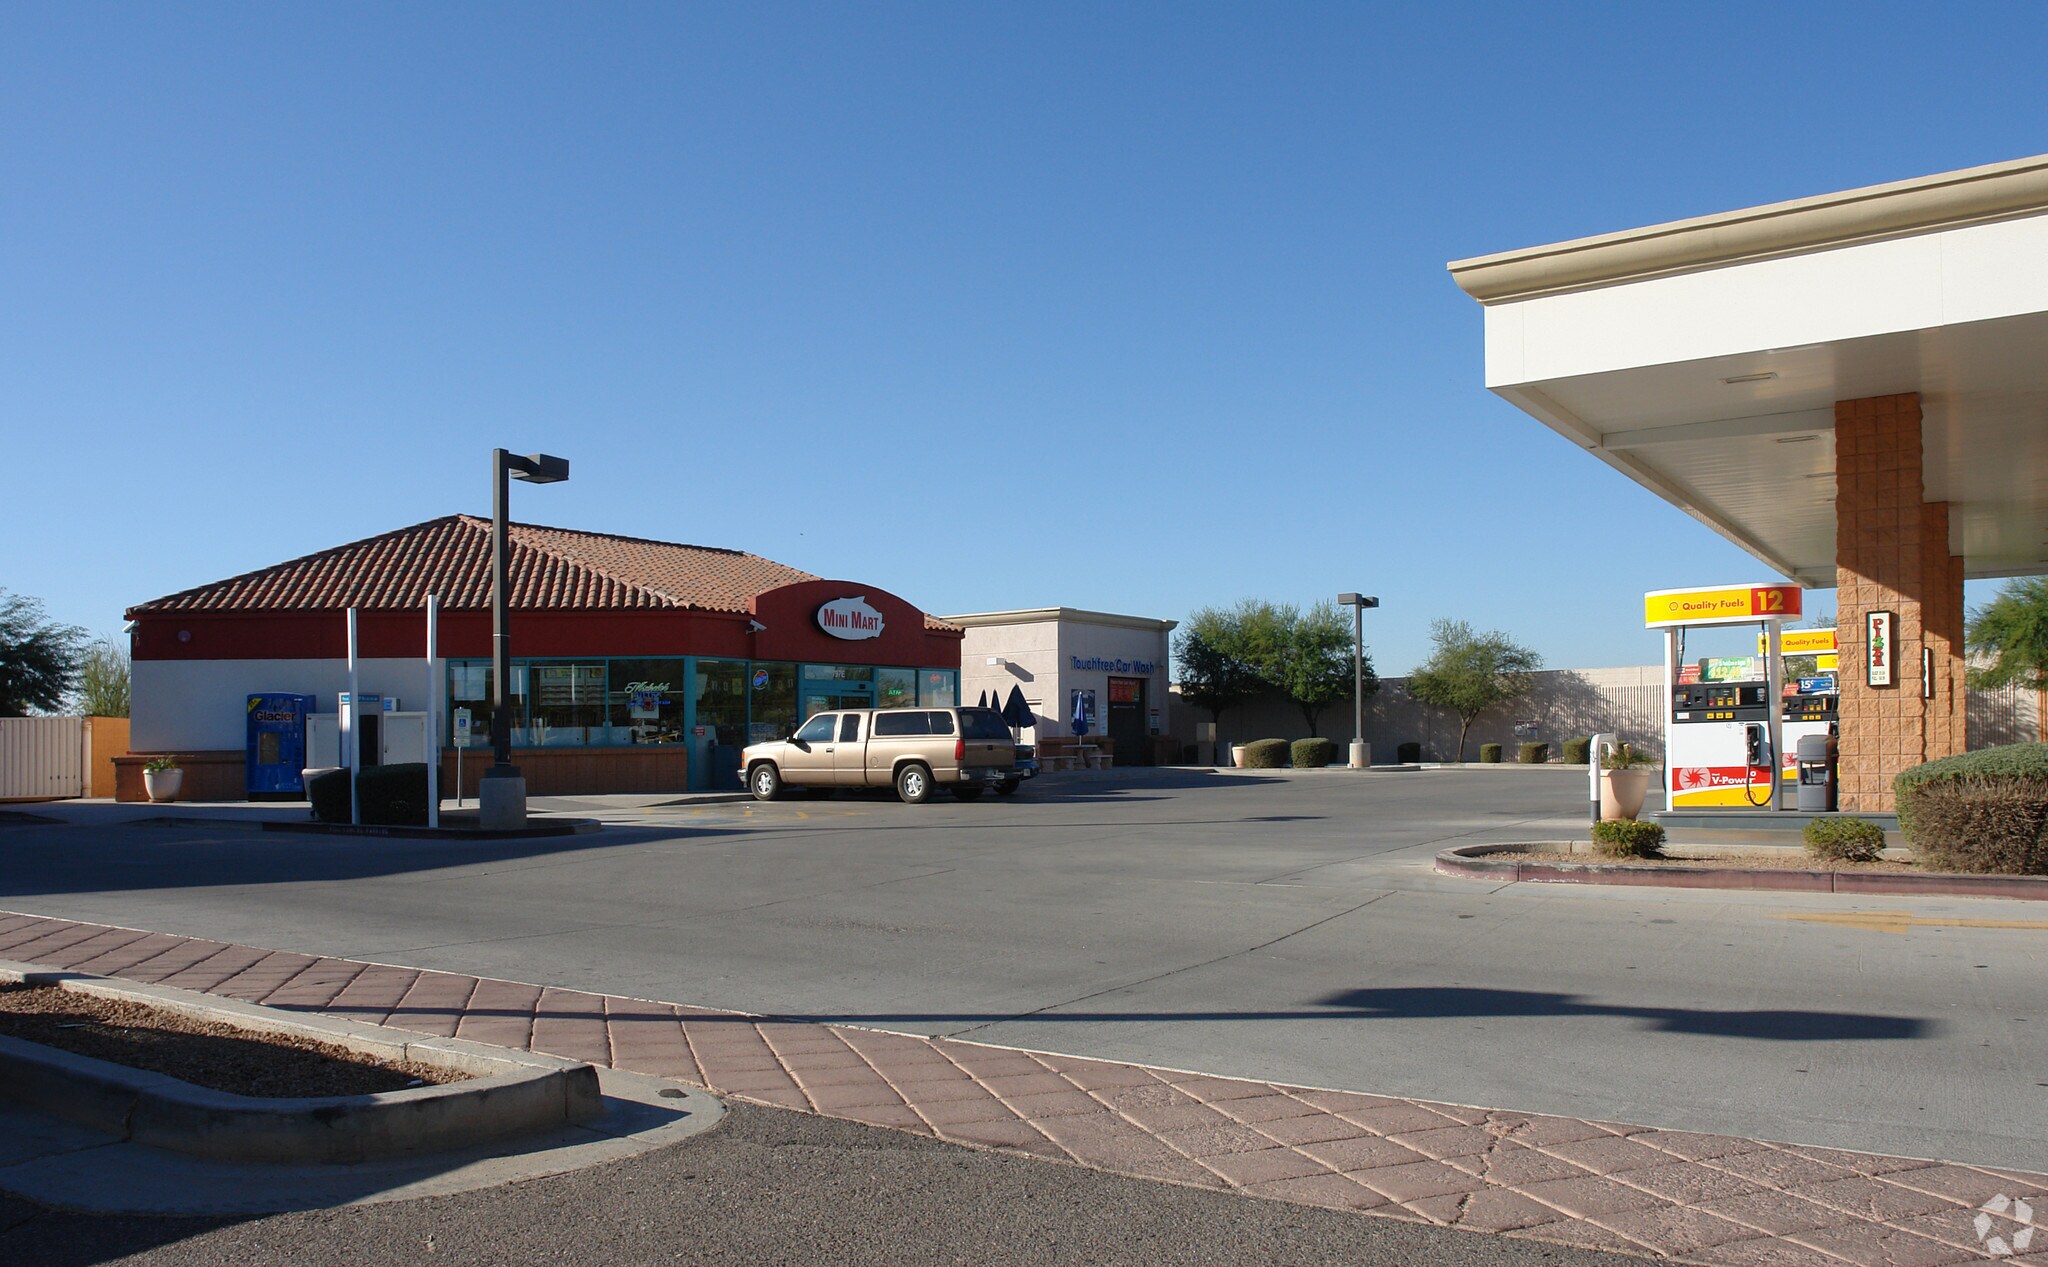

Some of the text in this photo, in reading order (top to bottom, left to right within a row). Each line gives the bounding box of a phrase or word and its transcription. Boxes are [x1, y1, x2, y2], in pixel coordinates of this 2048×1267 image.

[1682, 599, 1745, 611] Quality Fuels
[1757, 590, 1784, 611] 12
[1785, 637, 1830, 646] Quality Fuels
[1872, 618, 1885, 667] PIZZA
[1072, 656, 1155, 674] Touchfree Car Wash
[255, 711, 296, 721] Glacier
